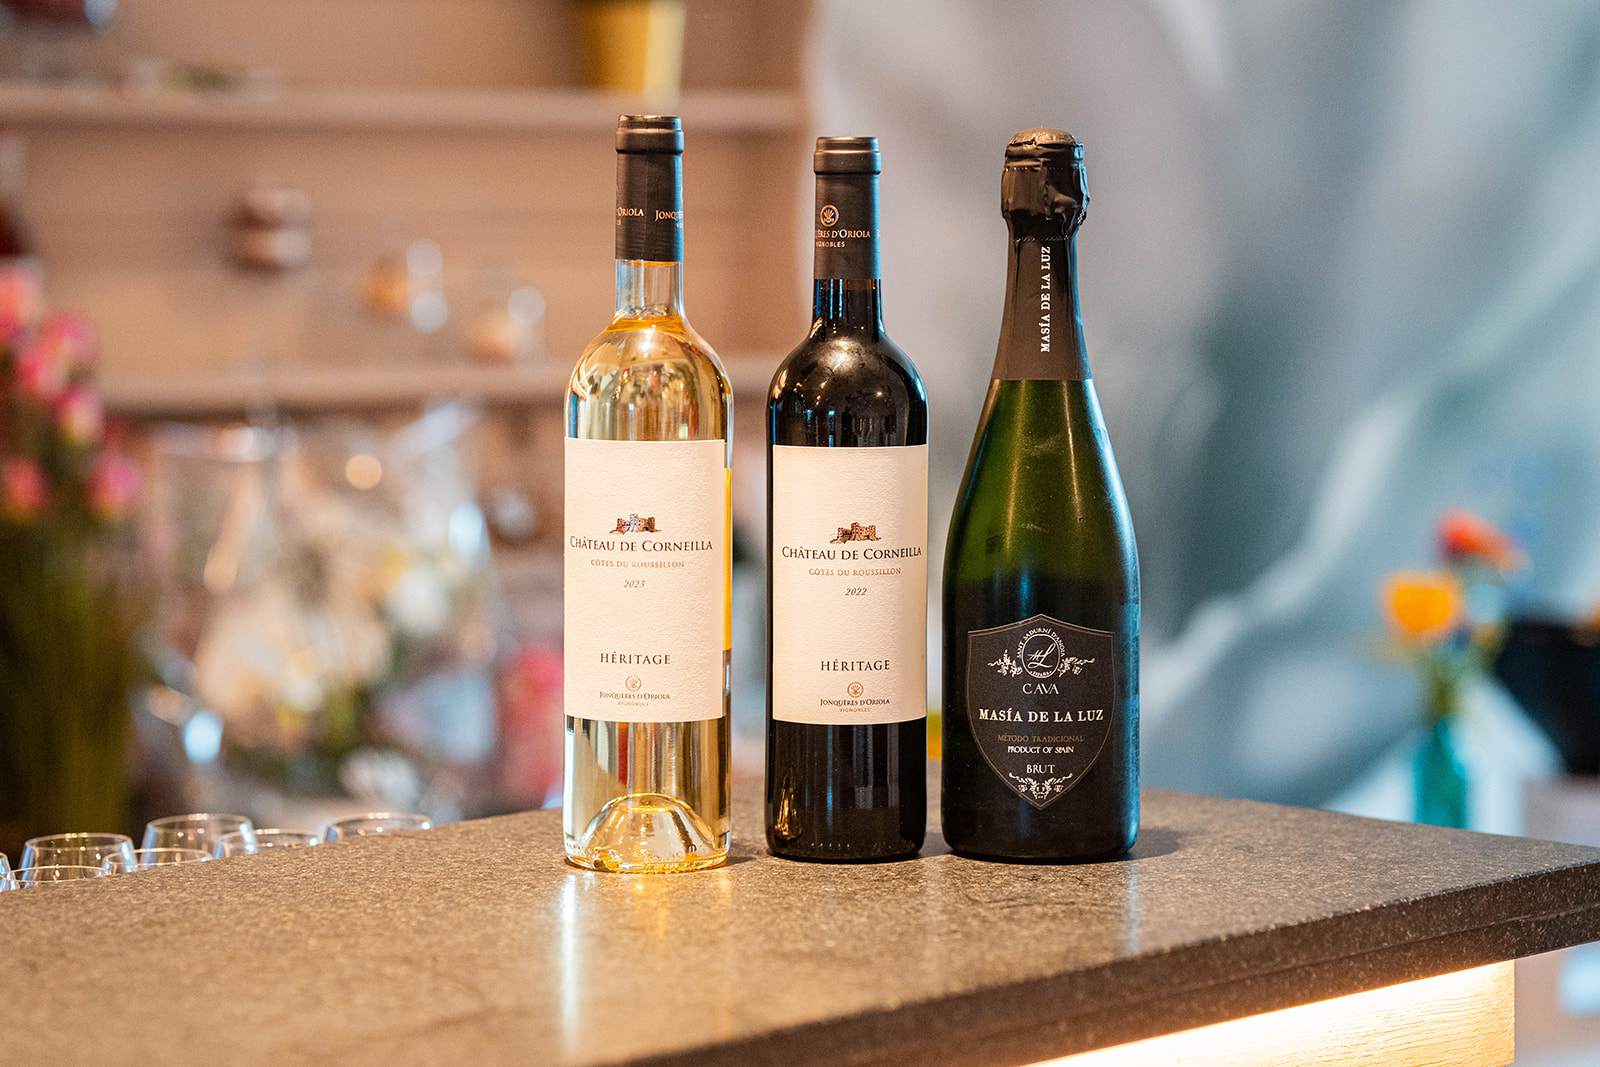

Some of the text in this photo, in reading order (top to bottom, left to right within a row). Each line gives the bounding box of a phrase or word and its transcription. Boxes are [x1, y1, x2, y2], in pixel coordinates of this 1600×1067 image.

[831, 228, 871, 239] D'ORIOLA
[1038, 246, 1051, 353] MASÍA DE LA LUZ
[569, 535, 713, 552] CHÂTEAU DE CORNEILLA
[781, 545, 922, 561] CHÂTEAU DE CORNEILLA
[590, 558, 685, 568] CÔTES DU ROUSSILLON
[808, 567, 902, 576] CÔTES DU ROUSSILLON
[844, 587, 868, 596] 2022
[600, 651, 671, 665] HÉRITAGE
[820, 658, 890, 672] HÉRITAGE
[1022, 682, 1060, 695] CAVA
[979, 707, 1104, 722] MASÍA DE LA LUZ
[997, 734, 1085, 743] MÉTODO TRADICIONAL
[1007, 745, 1075, 754] PRODUCT OF SPAIN
[1026, 764, 1056, 774] BRUT
